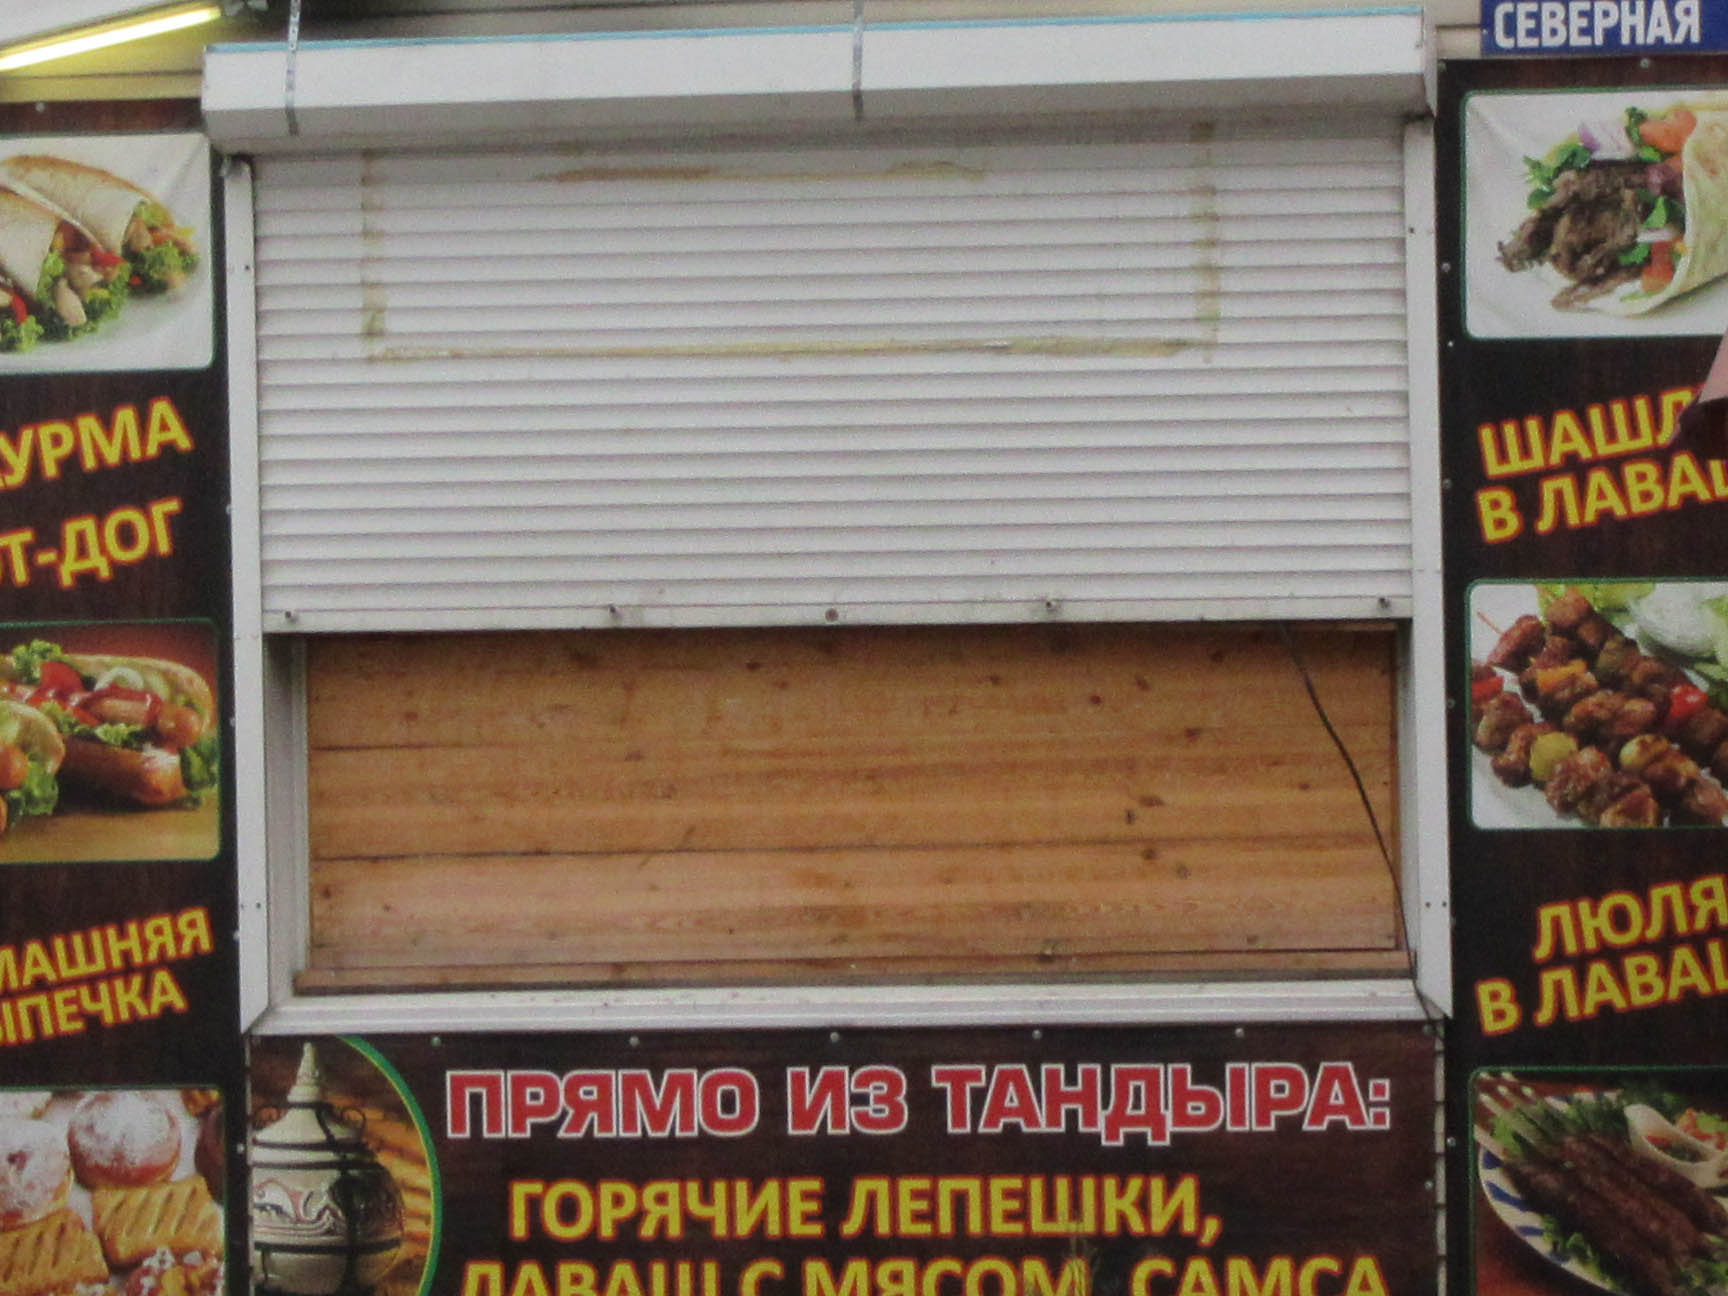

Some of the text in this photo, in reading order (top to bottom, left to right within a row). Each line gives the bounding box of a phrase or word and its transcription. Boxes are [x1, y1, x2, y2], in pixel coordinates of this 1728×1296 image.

[1476, 388, 1699, 477] ШАШЛ
[1475, 488, 1521, 542] В
[1475, 980, 1521, 1034] В
[444, 1060, 1392, 1147] ПРЯМО ИЗ ТАНДЫРА:
[509, 1175, 1222, 1247] ГОРЯЧИЕ ЛЕПЕШКИ,
